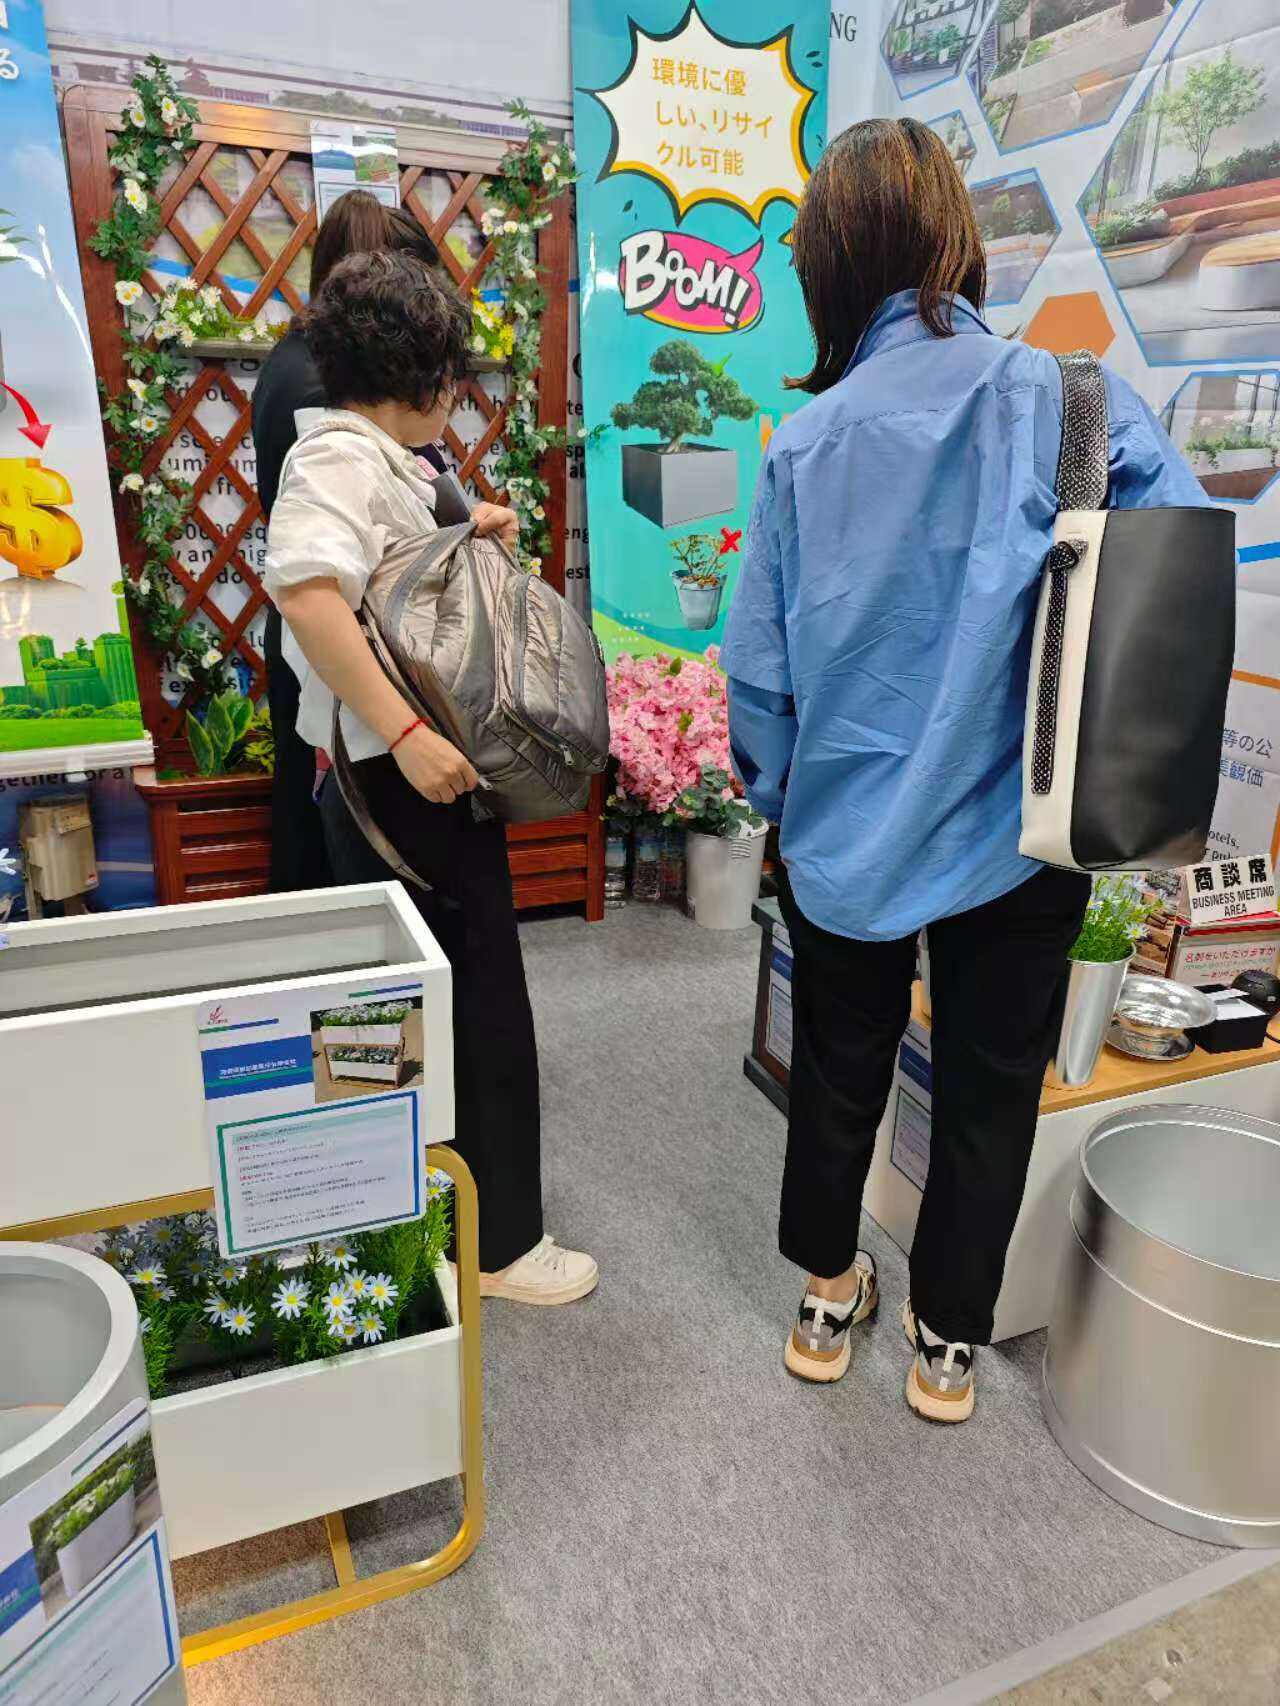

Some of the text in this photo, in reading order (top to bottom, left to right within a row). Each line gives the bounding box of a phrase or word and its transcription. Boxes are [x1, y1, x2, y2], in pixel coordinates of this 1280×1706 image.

[652, 57, 747, 96] 環境に優
[656, 101, 773, 139] しい、リサイ
[657, 140, 745, 177] クル可能
[1192, 857, 1267, 893] 商談席
[1191, 885, 1275, 910] BUSINESS MEETING
[1223, 904, 1247, 917] AREA
